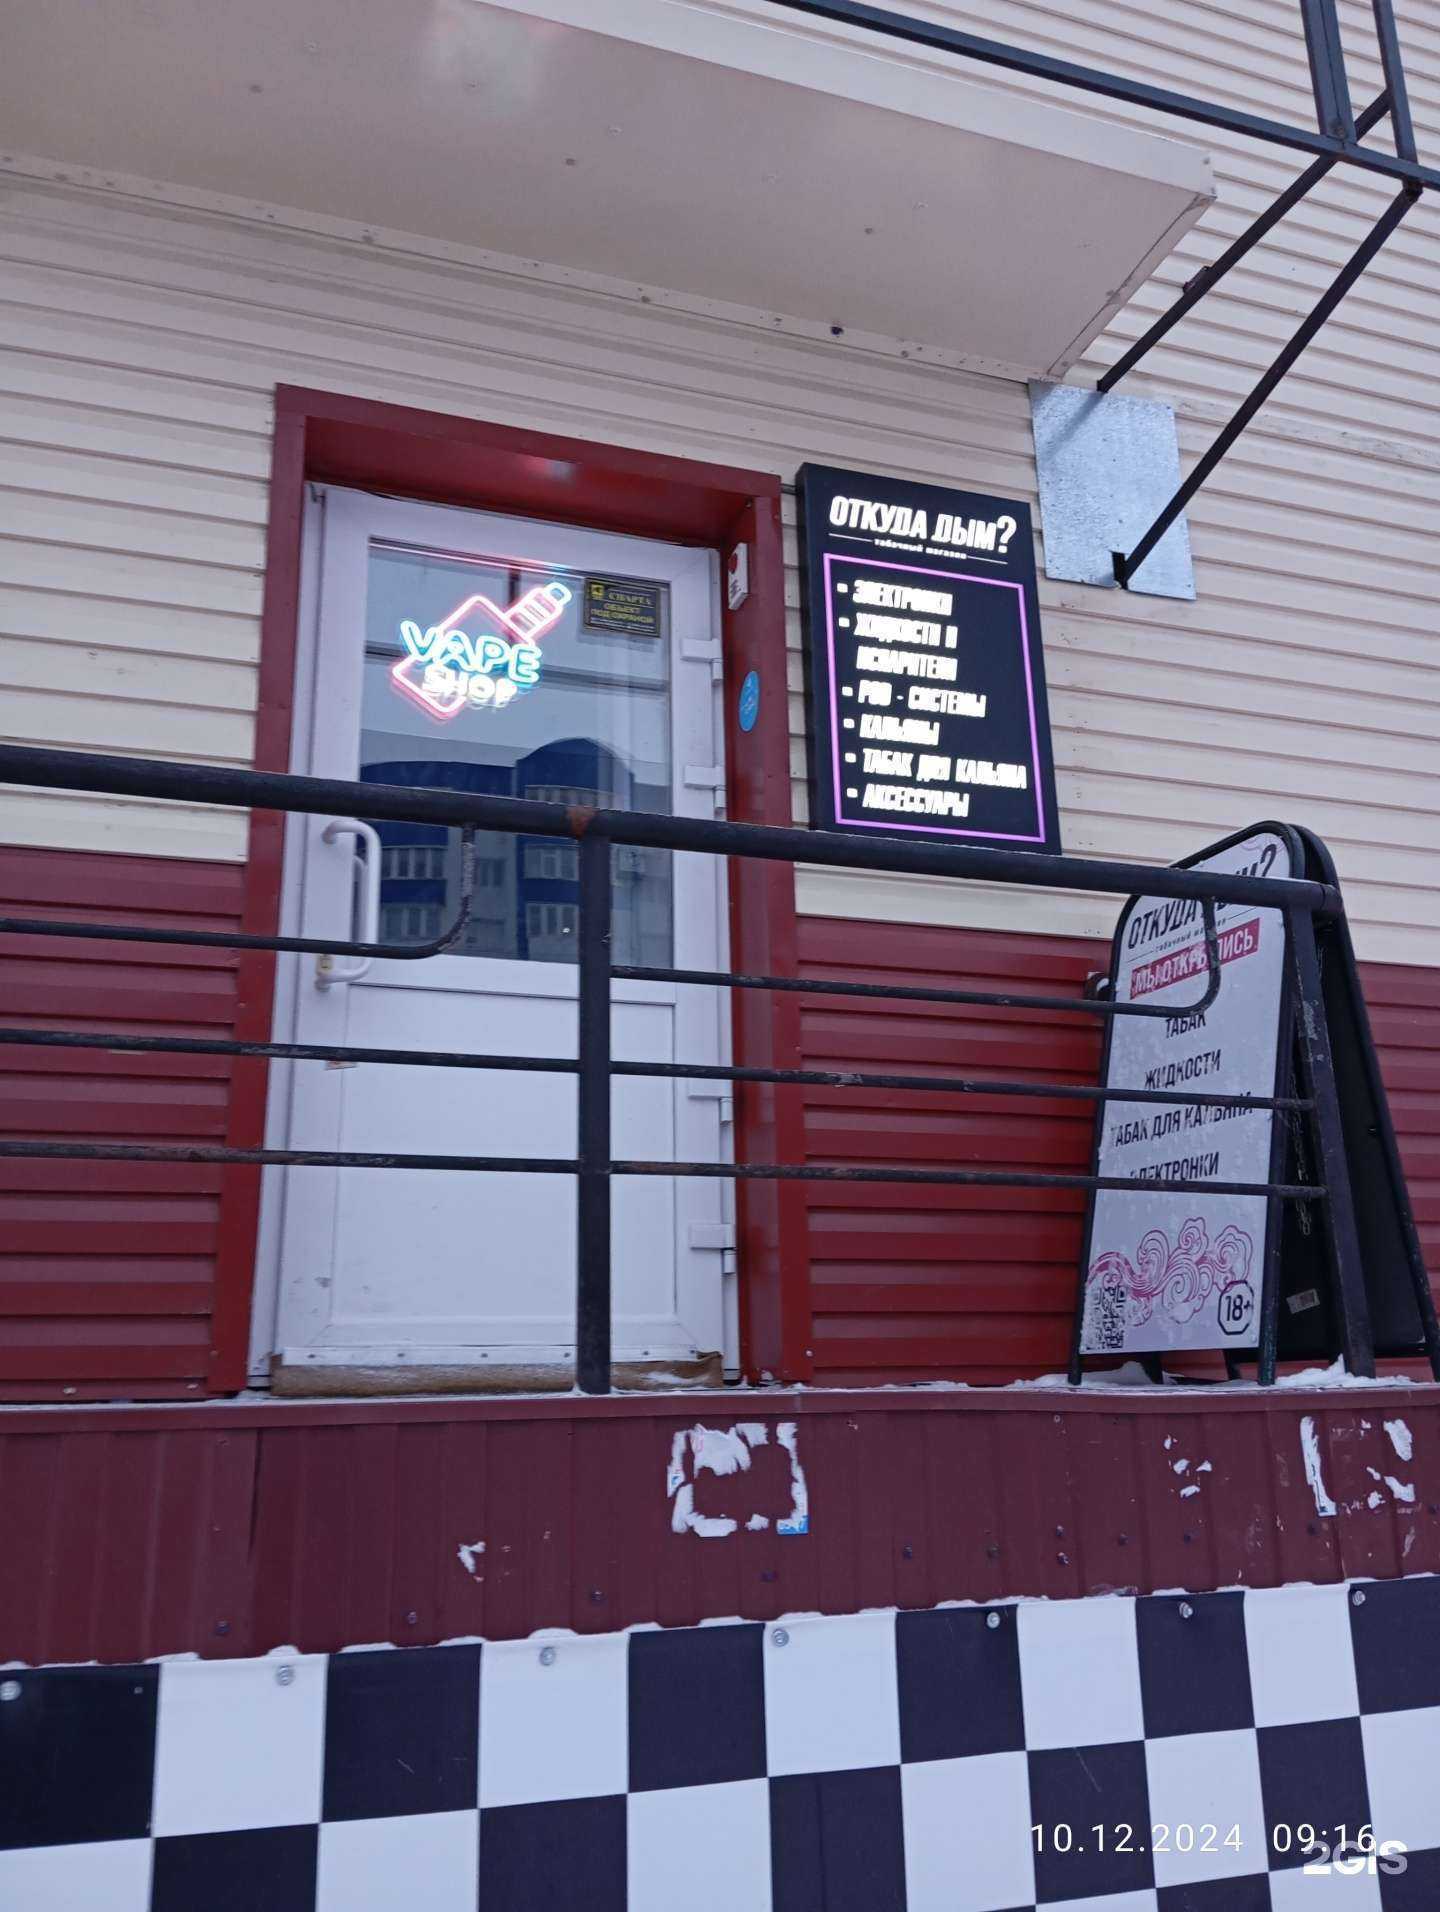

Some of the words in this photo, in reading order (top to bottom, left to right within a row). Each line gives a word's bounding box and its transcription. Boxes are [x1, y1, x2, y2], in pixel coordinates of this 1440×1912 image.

[829, 496, 928, 539] ОТКУДА
[931, 513, 1018, 554] ДЫМ?
[874, 538, 924, 553] табачный
[853, 612, 942, 647] ЖИДКОСТИ
[400, 620, 543, 684] VAPE
[422, 664, 518, 708] SHOP
[907, 685, 987, 718] СИСТЕМЫ
[859, 713, 940, 746] КАЛЬЯНЫ
[862, 748, 914, 777] ТАБАК
[916, 754, 952, 782] ДЛЯ
[955, 758, 1028, 789] КАЛЬЯНА
[861, 783, 970, 818] АКСЕССУАРЫ
[1127, 899, 1197, 950] ОТКУДА
[1166, 1013, 1207, 1039] ТАБАК
[1145, 1048, 1222, 1090] ЖИДКОСТИ
[1151, 1110, 1181, 1141] ДЛЯ
[1225, 1294, 1253, 1322] 18+
